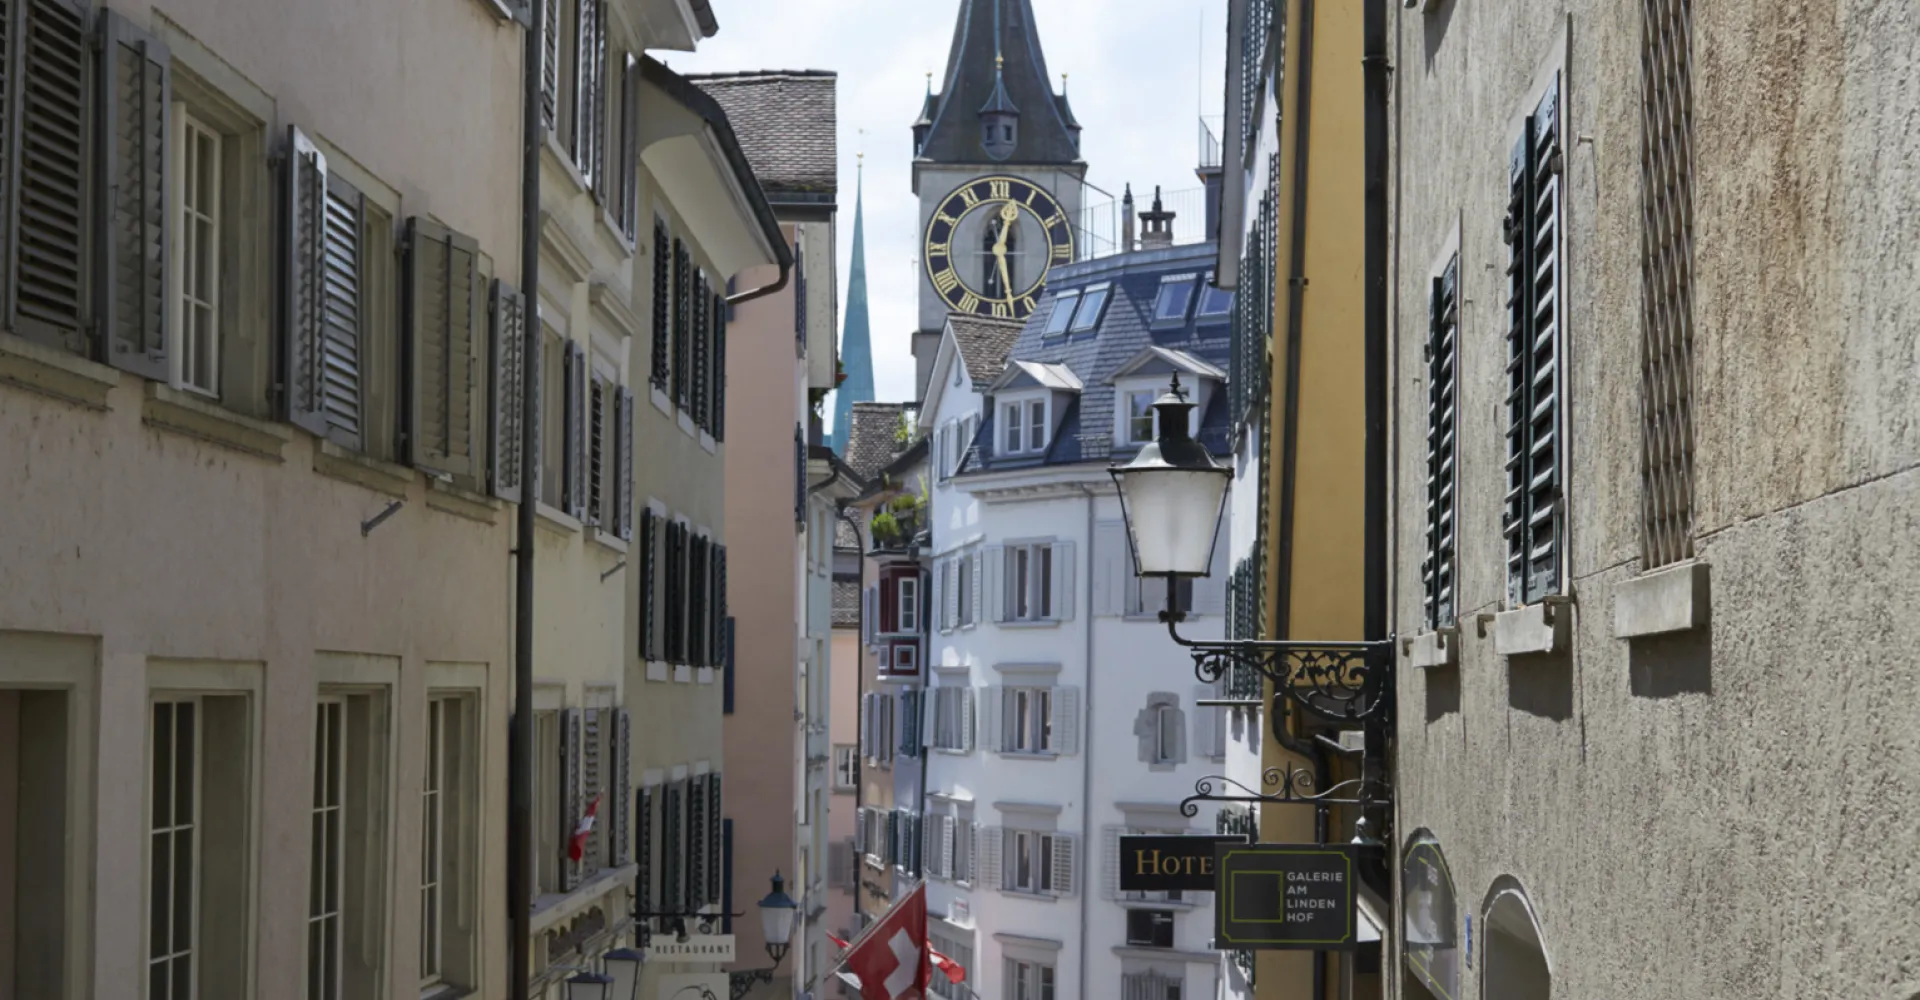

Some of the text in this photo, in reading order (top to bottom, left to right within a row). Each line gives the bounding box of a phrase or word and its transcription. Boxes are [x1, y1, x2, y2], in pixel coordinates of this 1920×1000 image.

[959, 186, 980, 208] XI
[989, 180, 1010, 199] XII
[1026, 188, 1037, 206] I
[937, 211, 957, 226] X
[929, 242, 947, 257] IX
[1051, 243, 1071, 258] III
[1134, 849, 1214, 875] HOTE
[1287, 871, 1343, 881] GALERIE
[1287, 885, 1307, 895] AM
[1287, 898, 1335, 909] LINDEN
[1287, 912, 1314, 922] HOF
[655, 945, 731, 954] RESTAURANT
